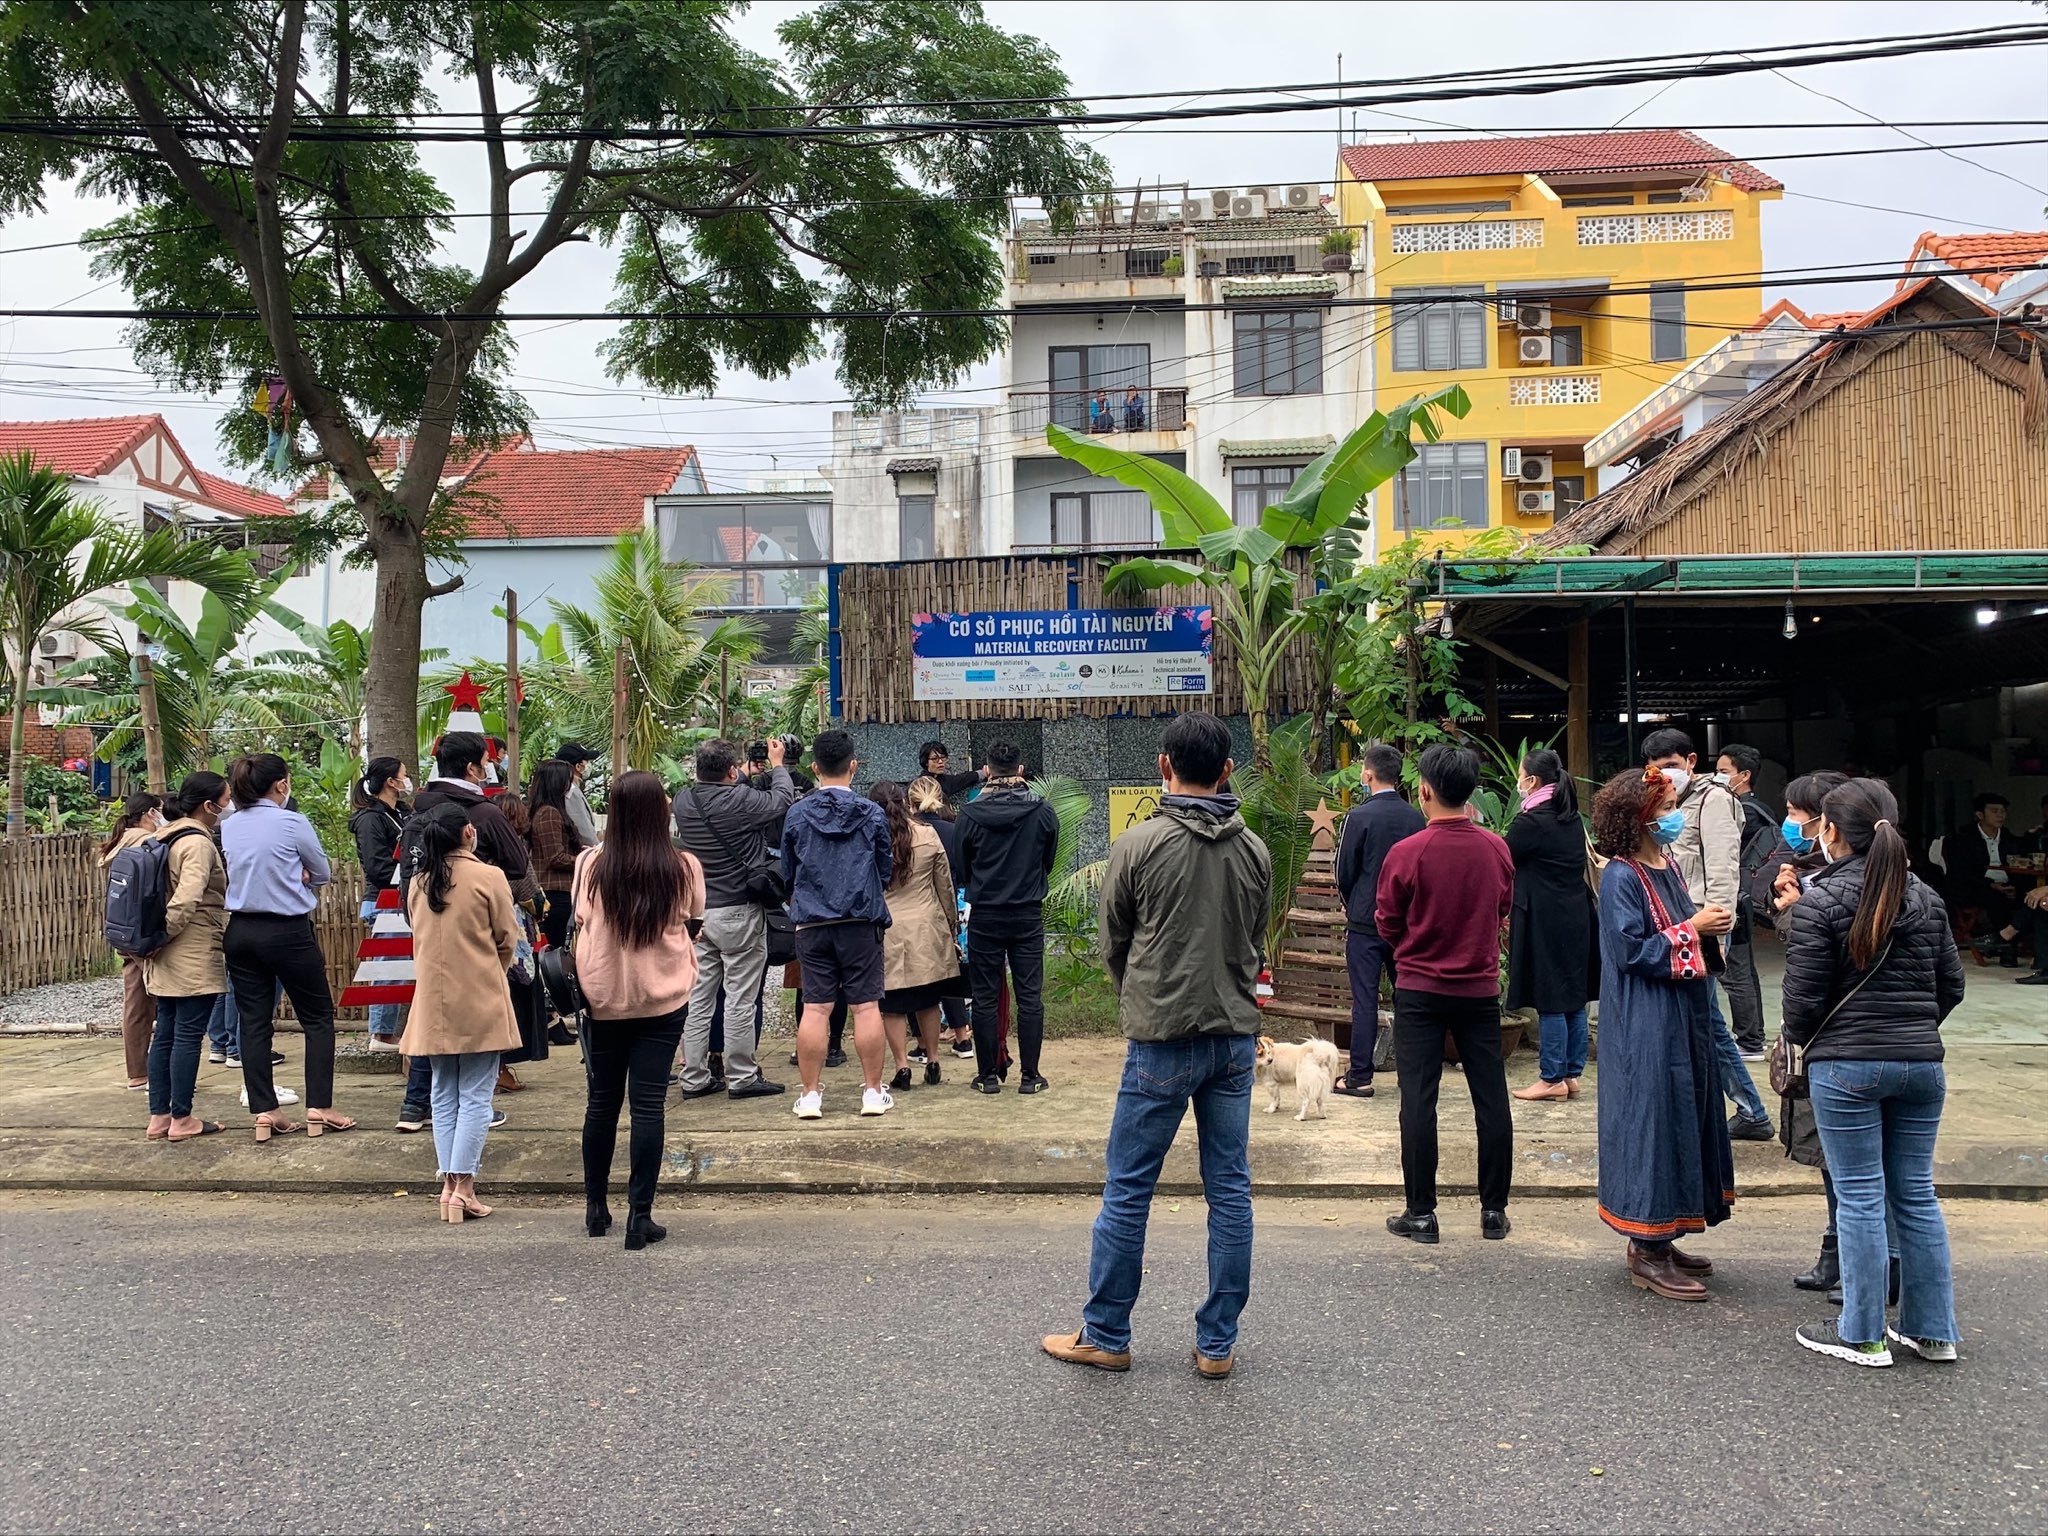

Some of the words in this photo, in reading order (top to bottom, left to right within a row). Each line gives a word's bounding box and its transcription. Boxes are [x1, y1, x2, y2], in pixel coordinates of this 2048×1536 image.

[949, 619, 971, 637] CƠ
[975, 615, 996, 637] SỞ
[1001, 618, 1044, 639] PHỤC
[1049, 612, 1077, 635] HỒI
[1082, 612, 1106, 634] TÀI
[1112, 611, 1173, 633] NGUYÊN
[974, 641, 1031, 655] MATERIAL
[1034, 639, 1094, 653] RECOVERY
[1097, 638, 1148, 651] FACILITY
[1008, 683, 1033, 692] SALT
